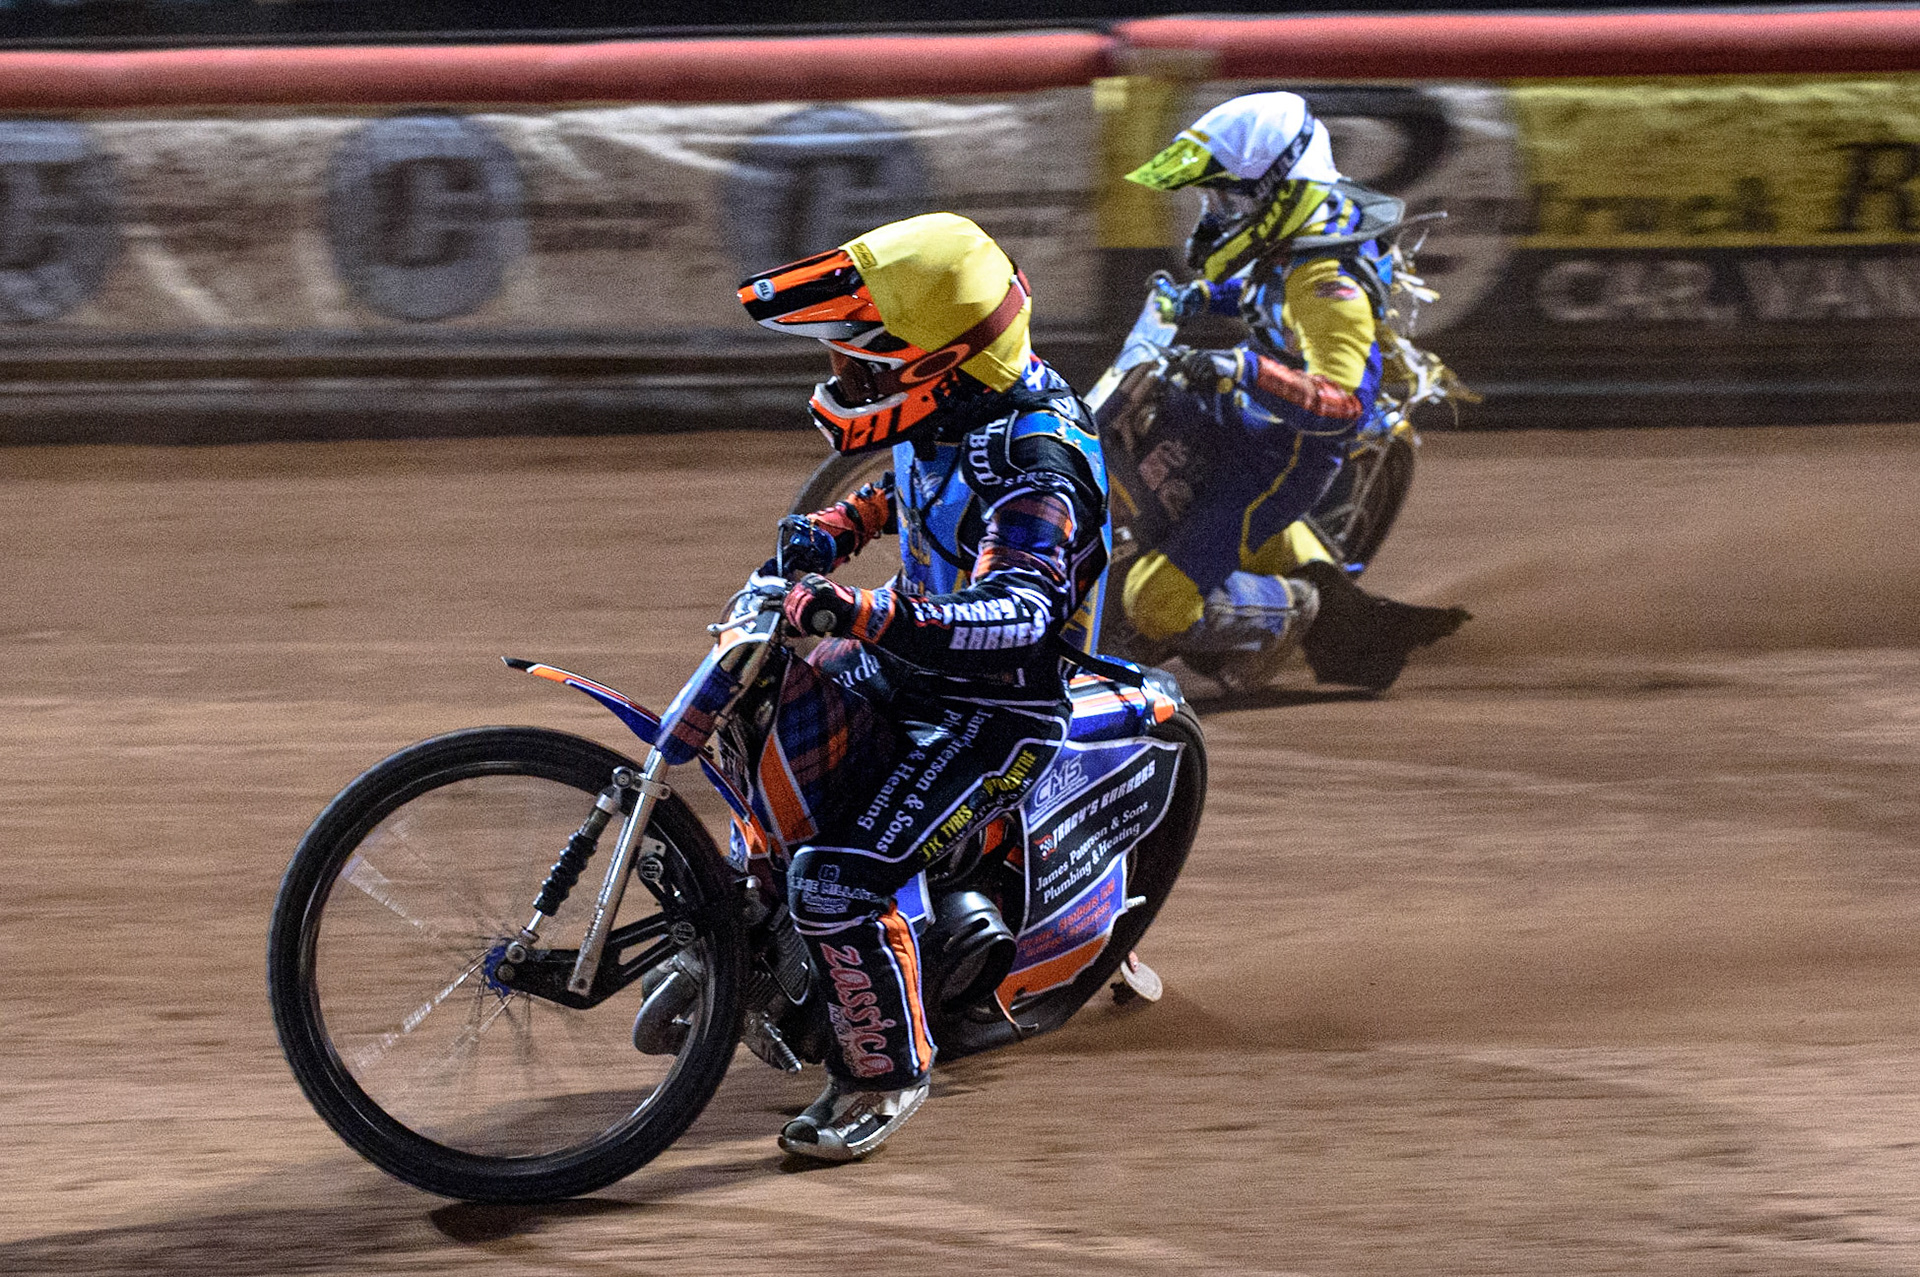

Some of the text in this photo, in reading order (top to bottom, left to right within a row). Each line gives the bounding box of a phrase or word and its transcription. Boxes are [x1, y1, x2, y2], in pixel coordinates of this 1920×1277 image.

[856, 762, 916, 831] Heating
[1034, 753, 1083, 808] CMS
[1101, 759, 1156, 809] BARBERS
[876, 809, 914, 853] Sons
[940, 804, 974, 839] TYRES
[1036, 801, 1149, 892] James Paterson & Sons
[1043, 861, 1092, 905] Plumbing
[1099, 822, 1141, 856] Heating
